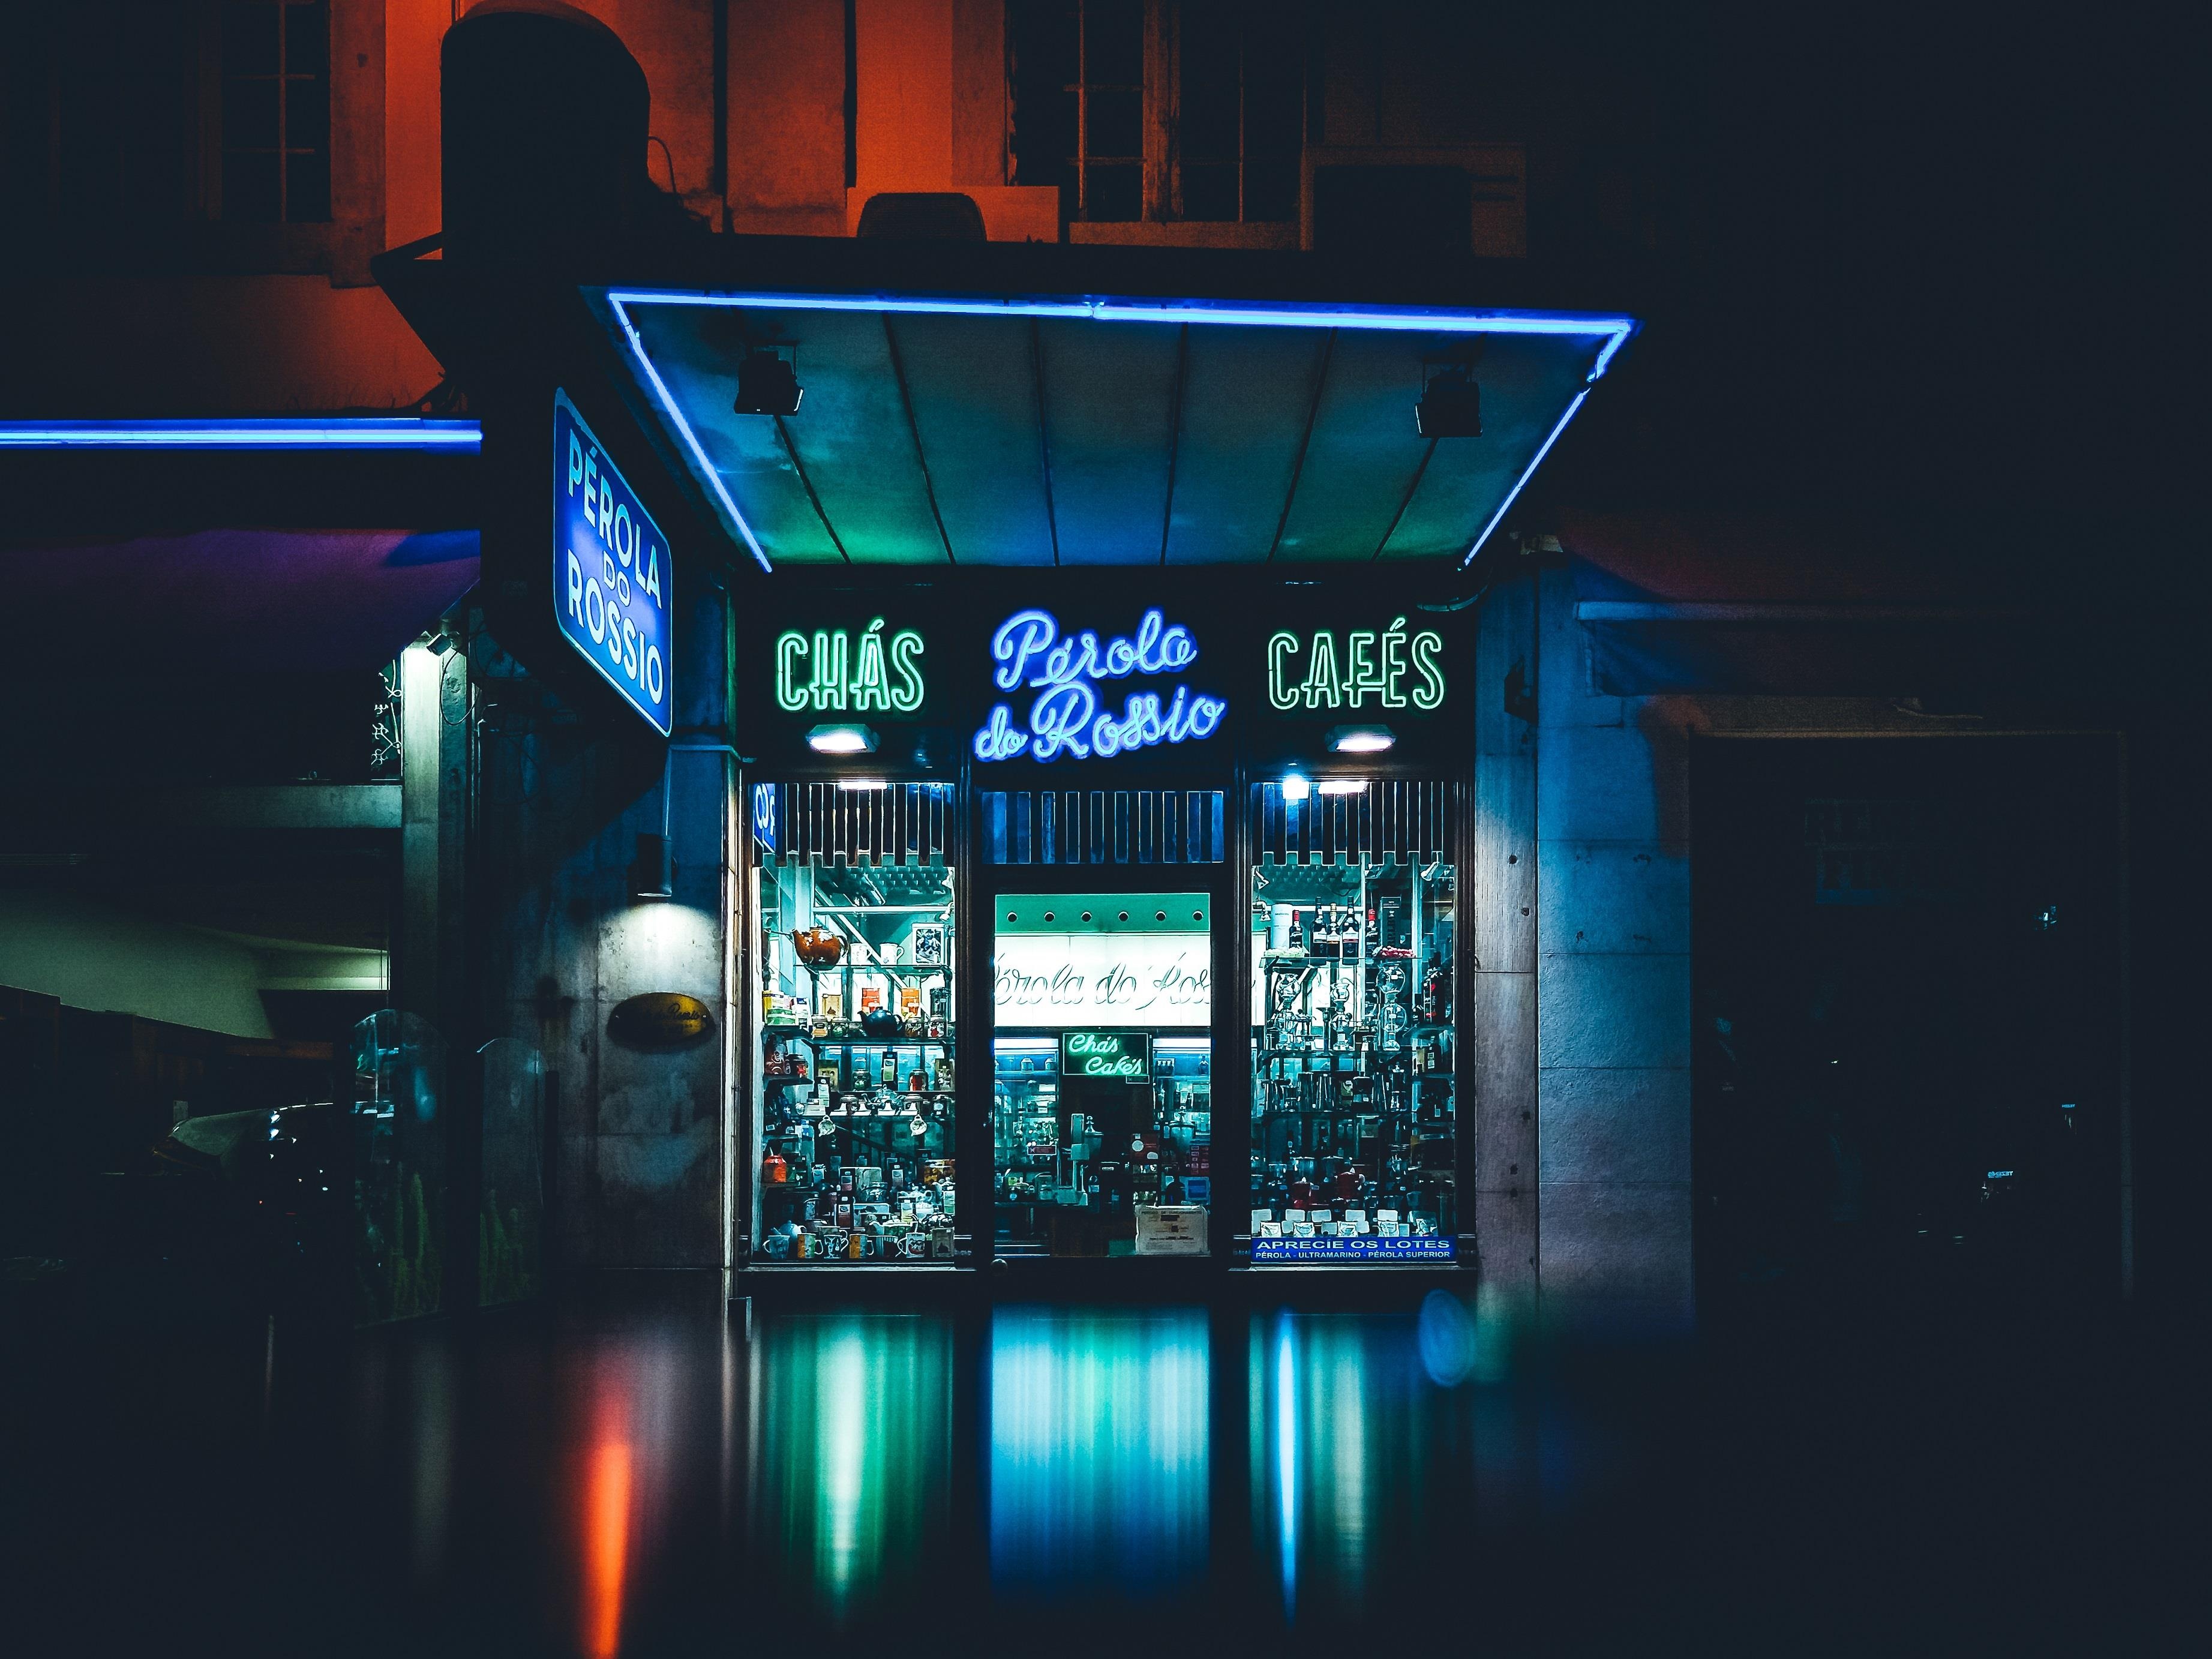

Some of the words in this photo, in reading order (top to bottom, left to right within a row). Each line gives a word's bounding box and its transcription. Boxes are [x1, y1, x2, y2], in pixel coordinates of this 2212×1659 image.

[568, 428, 662, 610] PÉROLA
[603, 550, 631, 607] DO
[567, 548, 663, 705] ROSSIO
[776, 618, 925, 712] CHÁS
[994, 608, 1197, 690] Pérola
[1268, 617, 1445, 710] CAFÉS
[976, 706, 1027, 758] do
[1033, 682, 1225, 758] Rossio
[1094, 962, 1136, 1004] do
[1350, 1240, 1378, 1249] OS
[1385, 1240, 1449, 1249] LOTES
